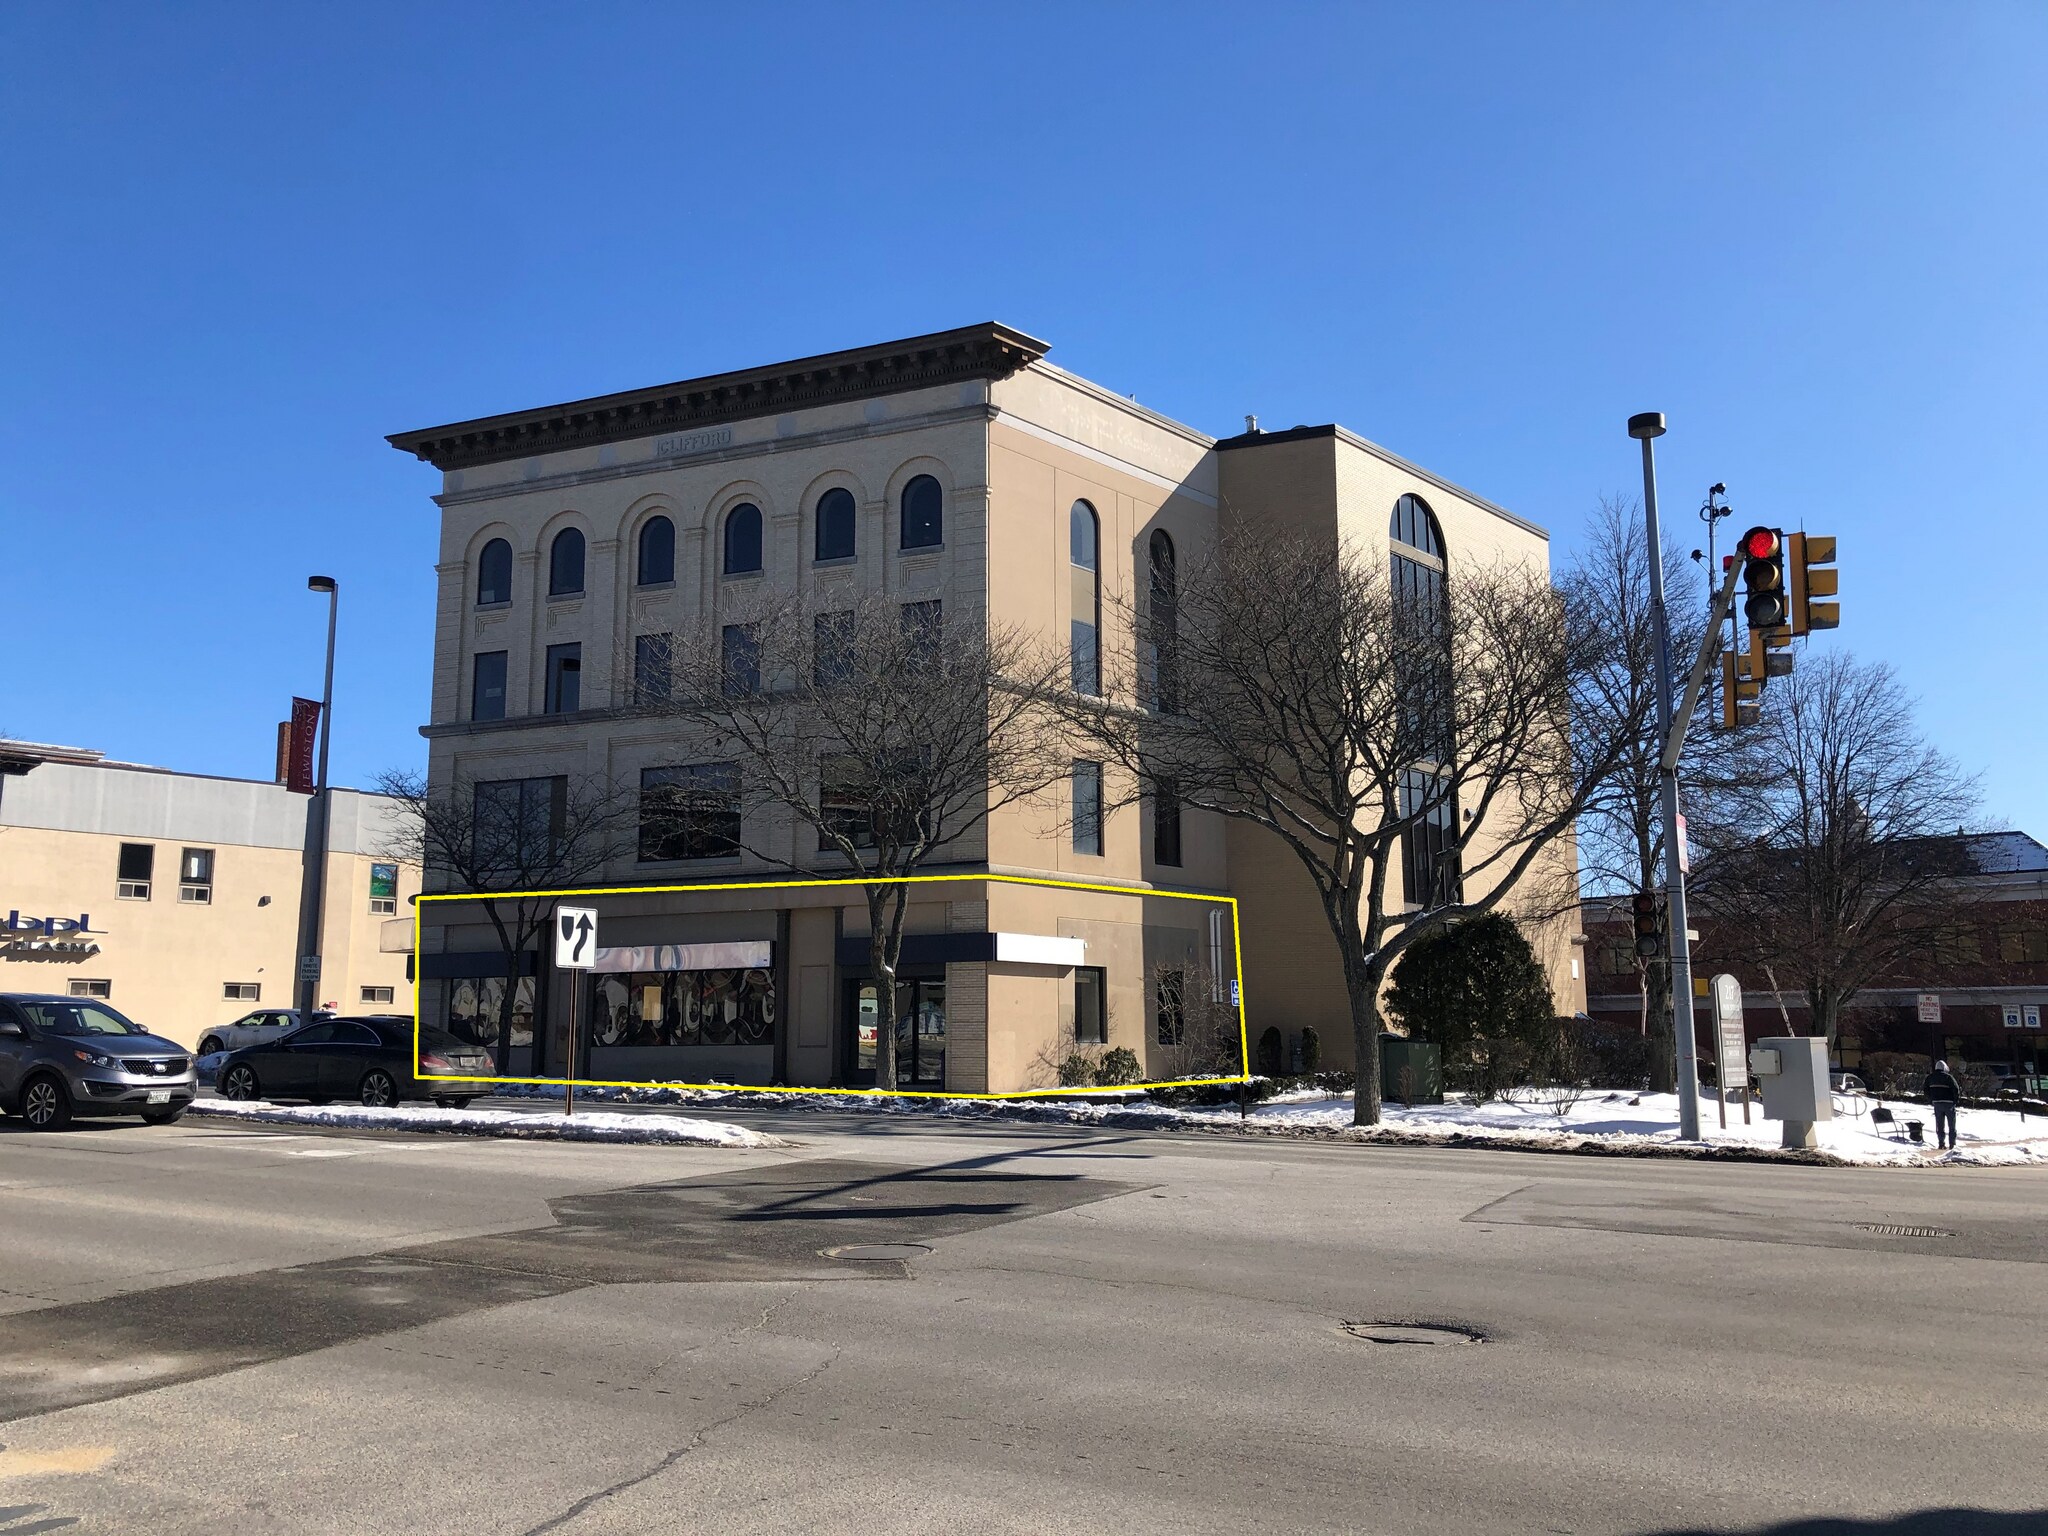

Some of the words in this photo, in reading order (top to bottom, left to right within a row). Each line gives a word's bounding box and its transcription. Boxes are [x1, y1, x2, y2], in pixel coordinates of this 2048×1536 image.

[660, 429, 732, 454] CLIFFORD
[303, 714, 316, 788] LEWISTON
[9, 909, 109, 937] bpl
[1724, 984, 1734, 1000] 217
